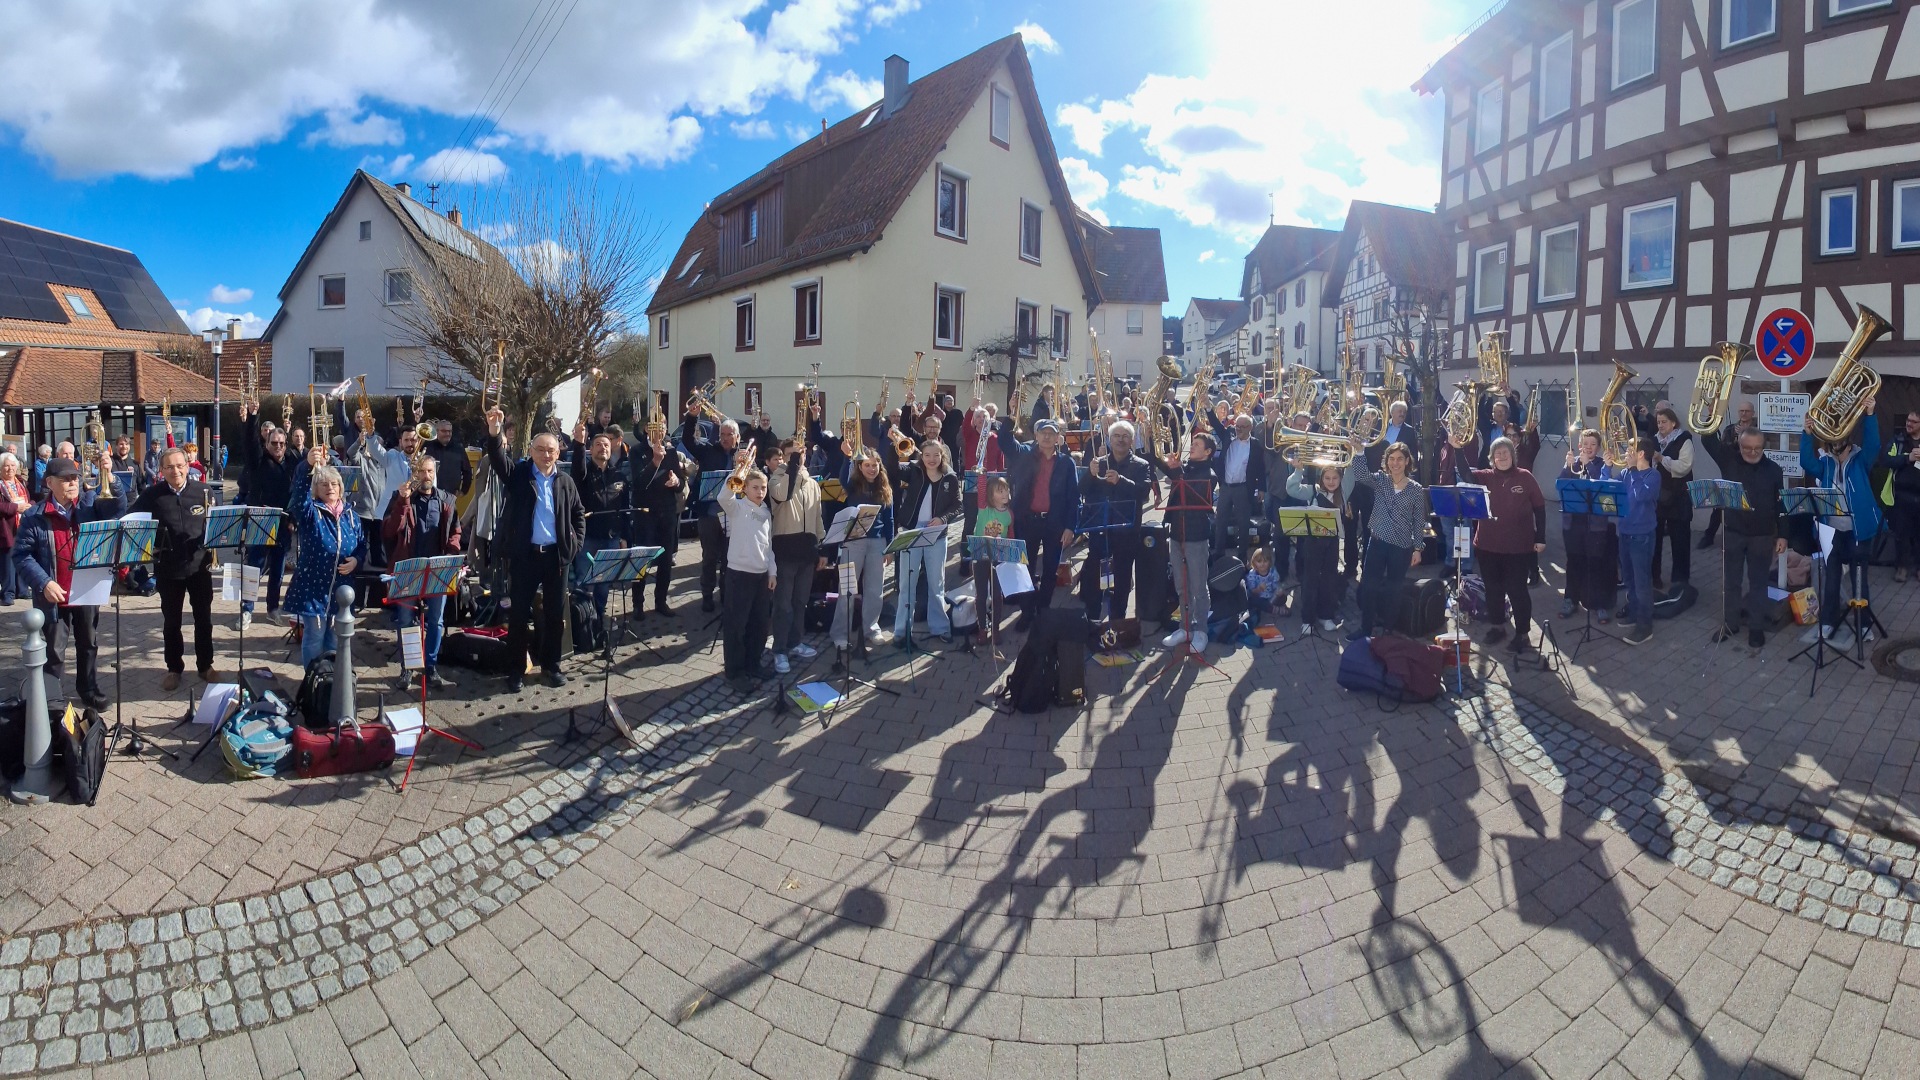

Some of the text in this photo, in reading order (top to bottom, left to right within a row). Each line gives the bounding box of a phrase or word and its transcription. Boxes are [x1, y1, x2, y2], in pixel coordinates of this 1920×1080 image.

[1774, 396, 1805, 406] Sonntag
[1780, 405, 1795, 413] Uhr
[1767, 452, 1799, 462] Gesamter
